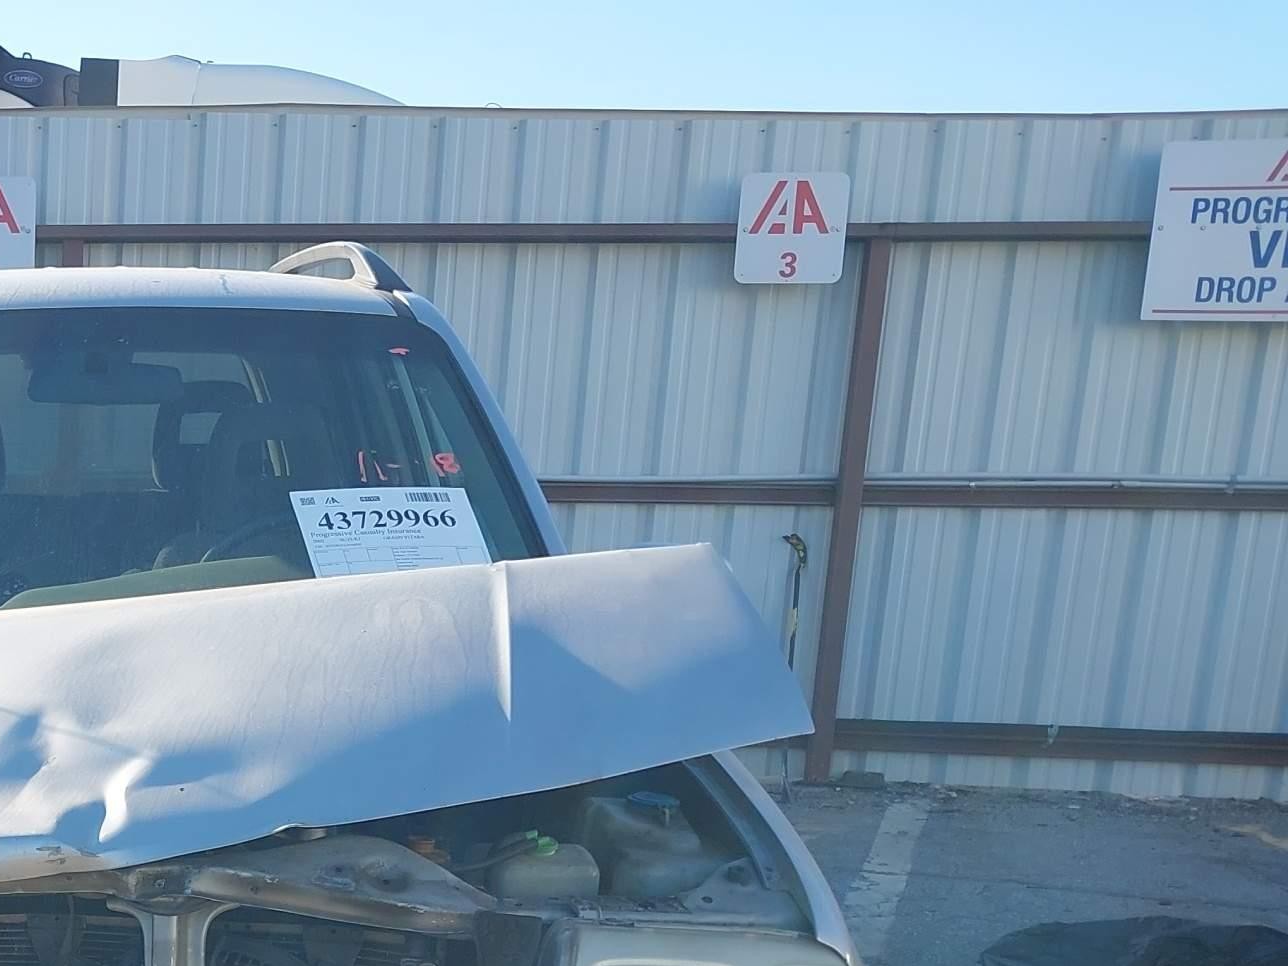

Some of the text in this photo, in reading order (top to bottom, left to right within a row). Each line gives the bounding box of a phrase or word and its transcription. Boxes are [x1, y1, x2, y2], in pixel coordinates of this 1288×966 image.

[778, 252, 798, 278] 3
[1194, 276, 1277, 303] DROP
[318, 508, 457, 531] 43729966
